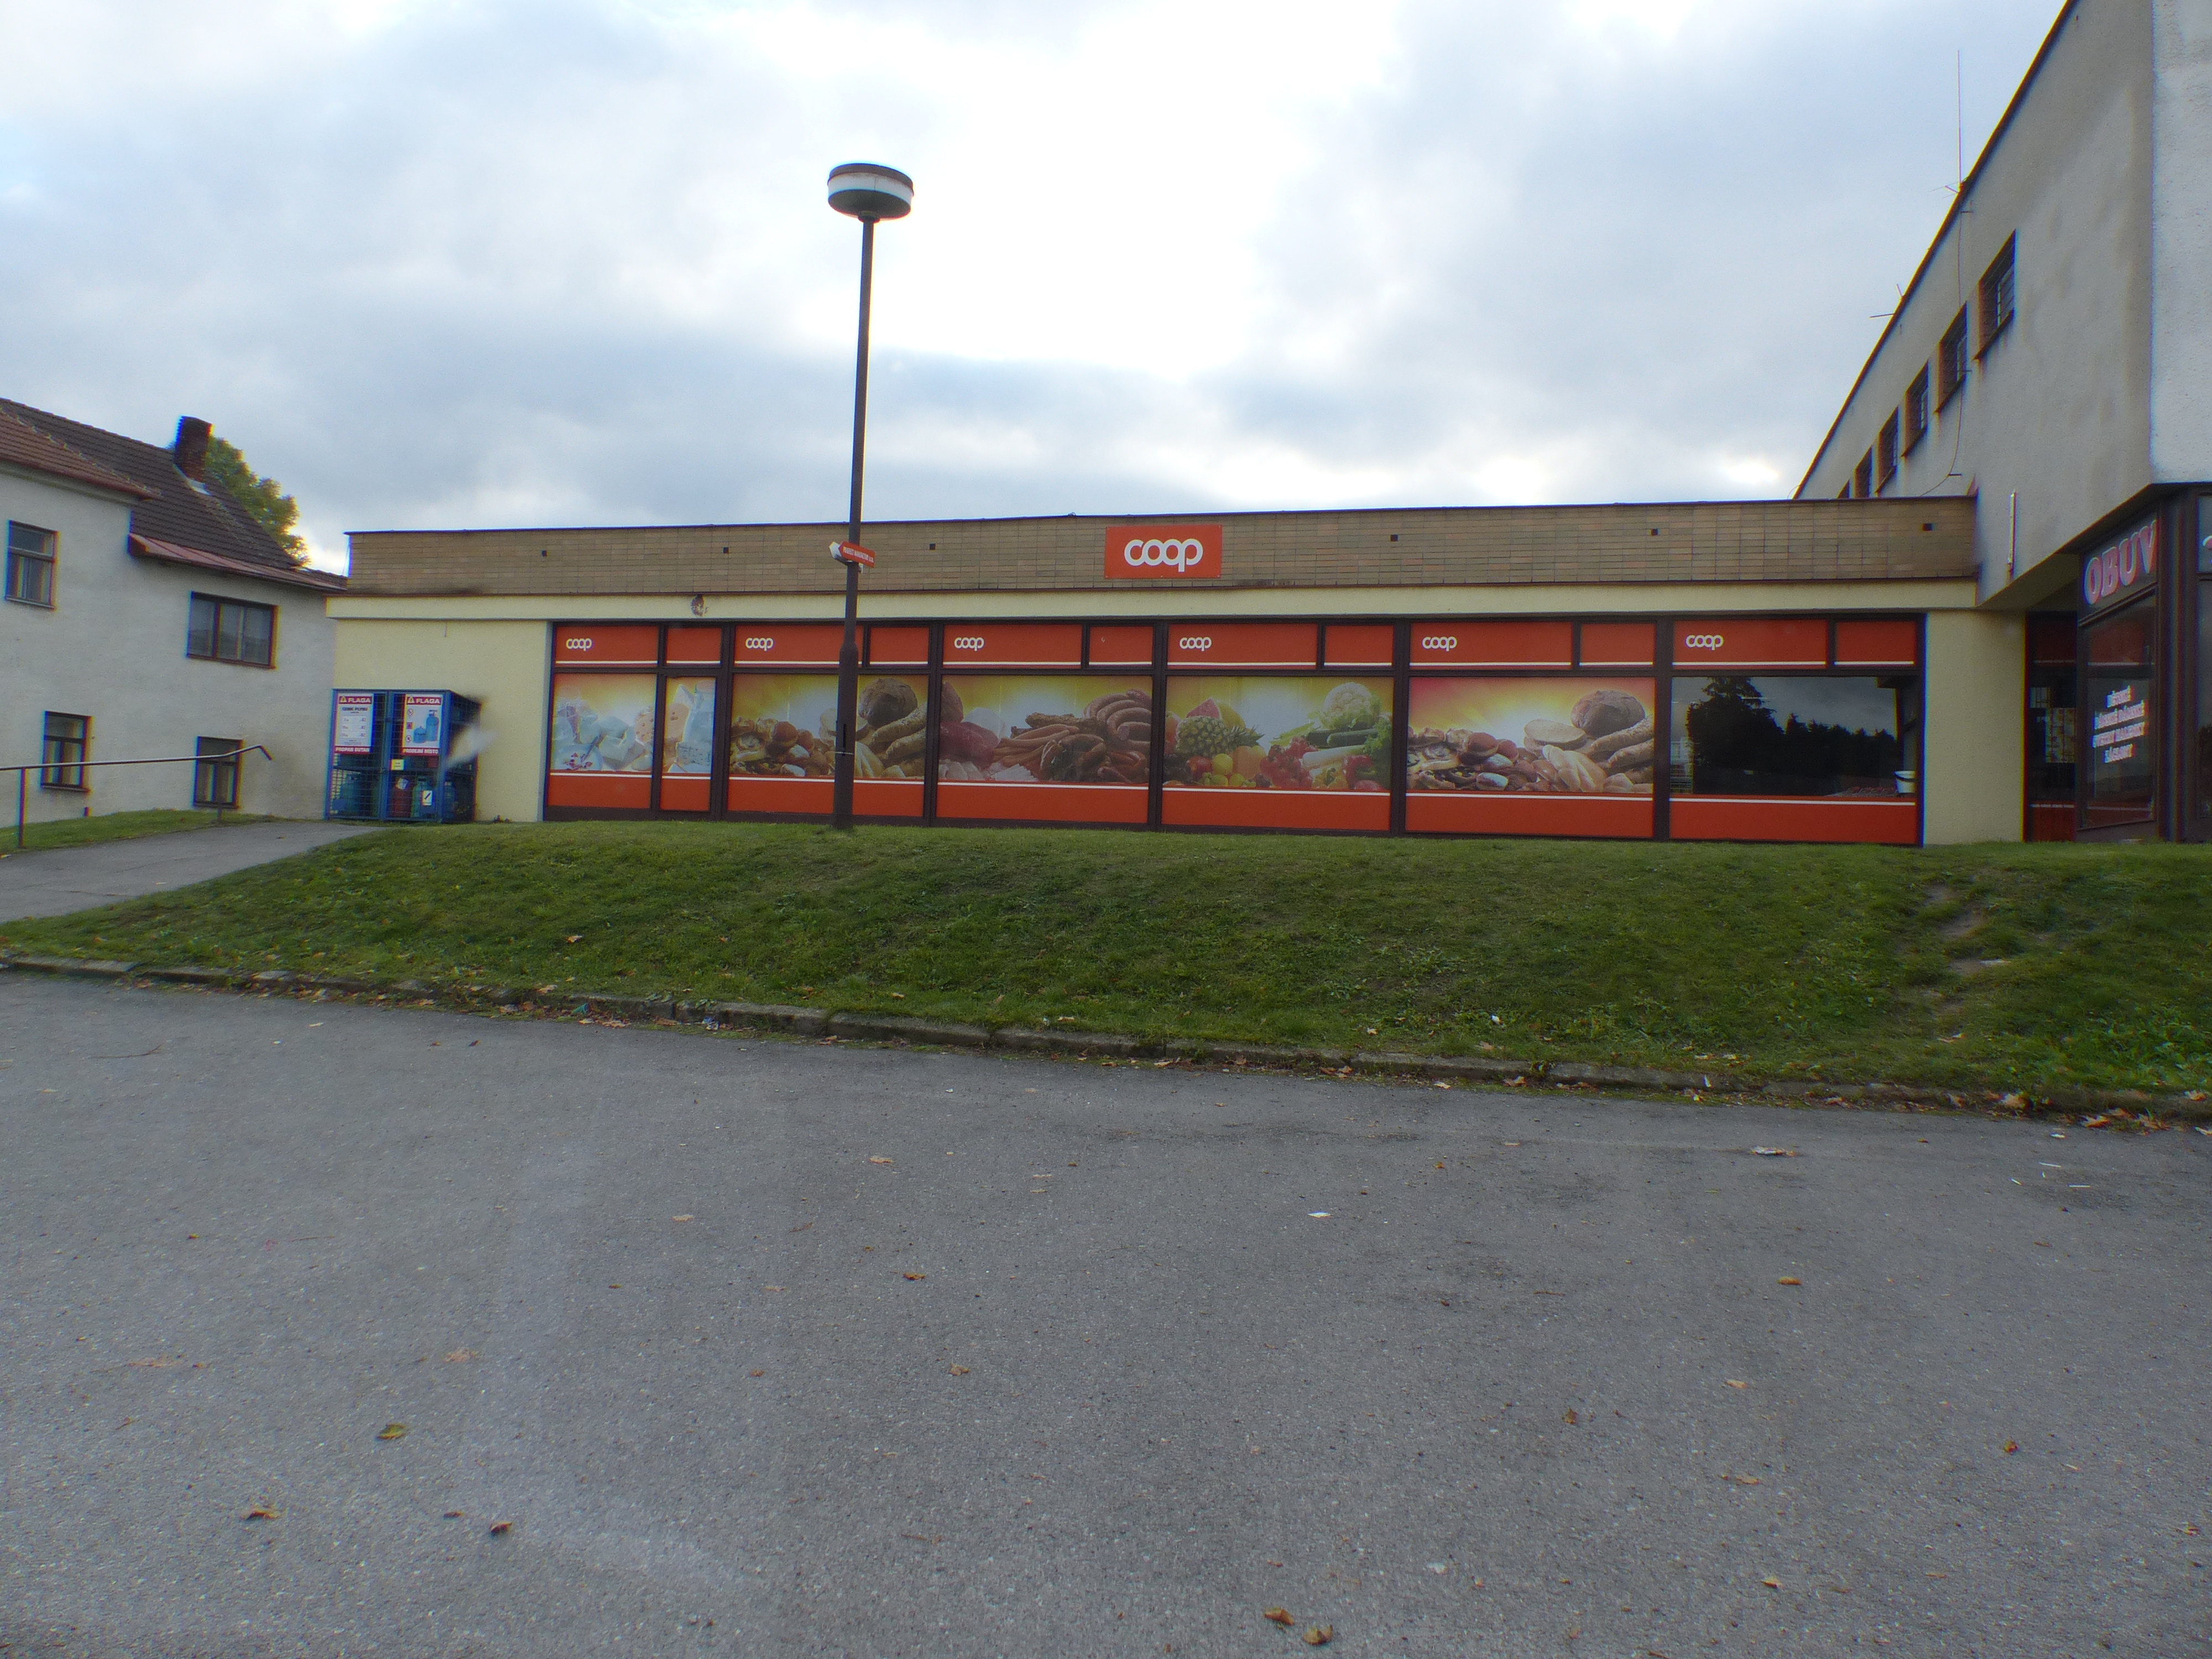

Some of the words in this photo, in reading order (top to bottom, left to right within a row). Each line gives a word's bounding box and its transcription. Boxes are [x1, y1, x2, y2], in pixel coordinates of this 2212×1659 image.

[1124, 538, 1203, 573] coop
[2083, 519, 2158, 606] OBUV
[566, 638, 592, 651] coop
[745, 637, 774, 651] coop
[954, 637, 984, 651] coop
[1179, 637, 1212, 652] coop
[1422, 636, 1458, 652] coop
[1686, 634, 1724, 651] coop
